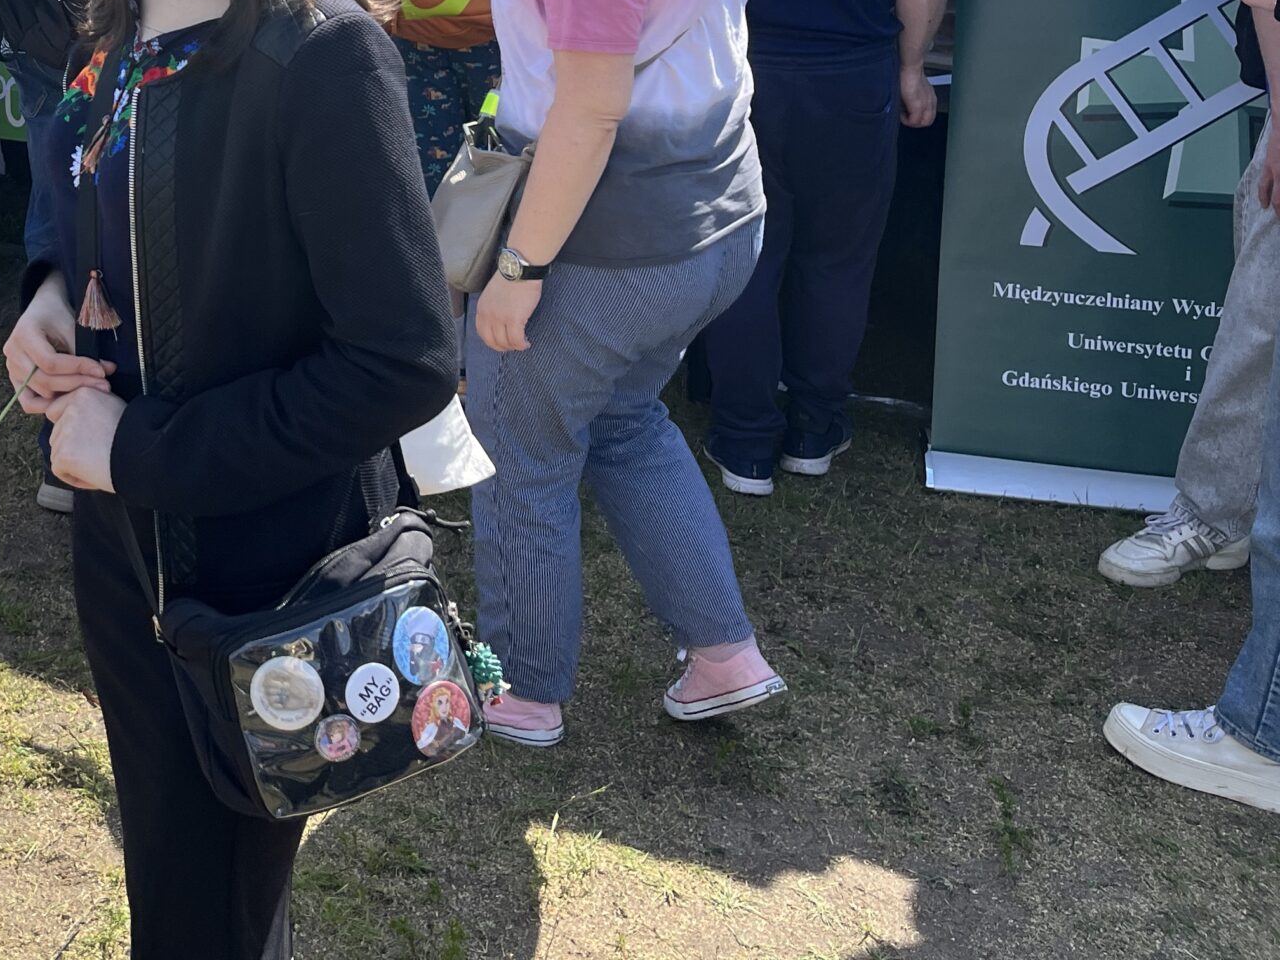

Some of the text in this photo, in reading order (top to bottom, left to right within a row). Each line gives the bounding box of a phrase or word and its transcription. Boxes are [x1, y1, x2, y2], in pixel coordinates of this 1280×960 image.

[992, 280, 1165, 317] Międzyuczelniany
[1067, 332, 1192, 360] Uniwersytetu
[1001, 369, 1201, 404] Gdańskiego Uniwers
[1185, 365, 1191, 382] i
[358, 675, 379, 703] MY
